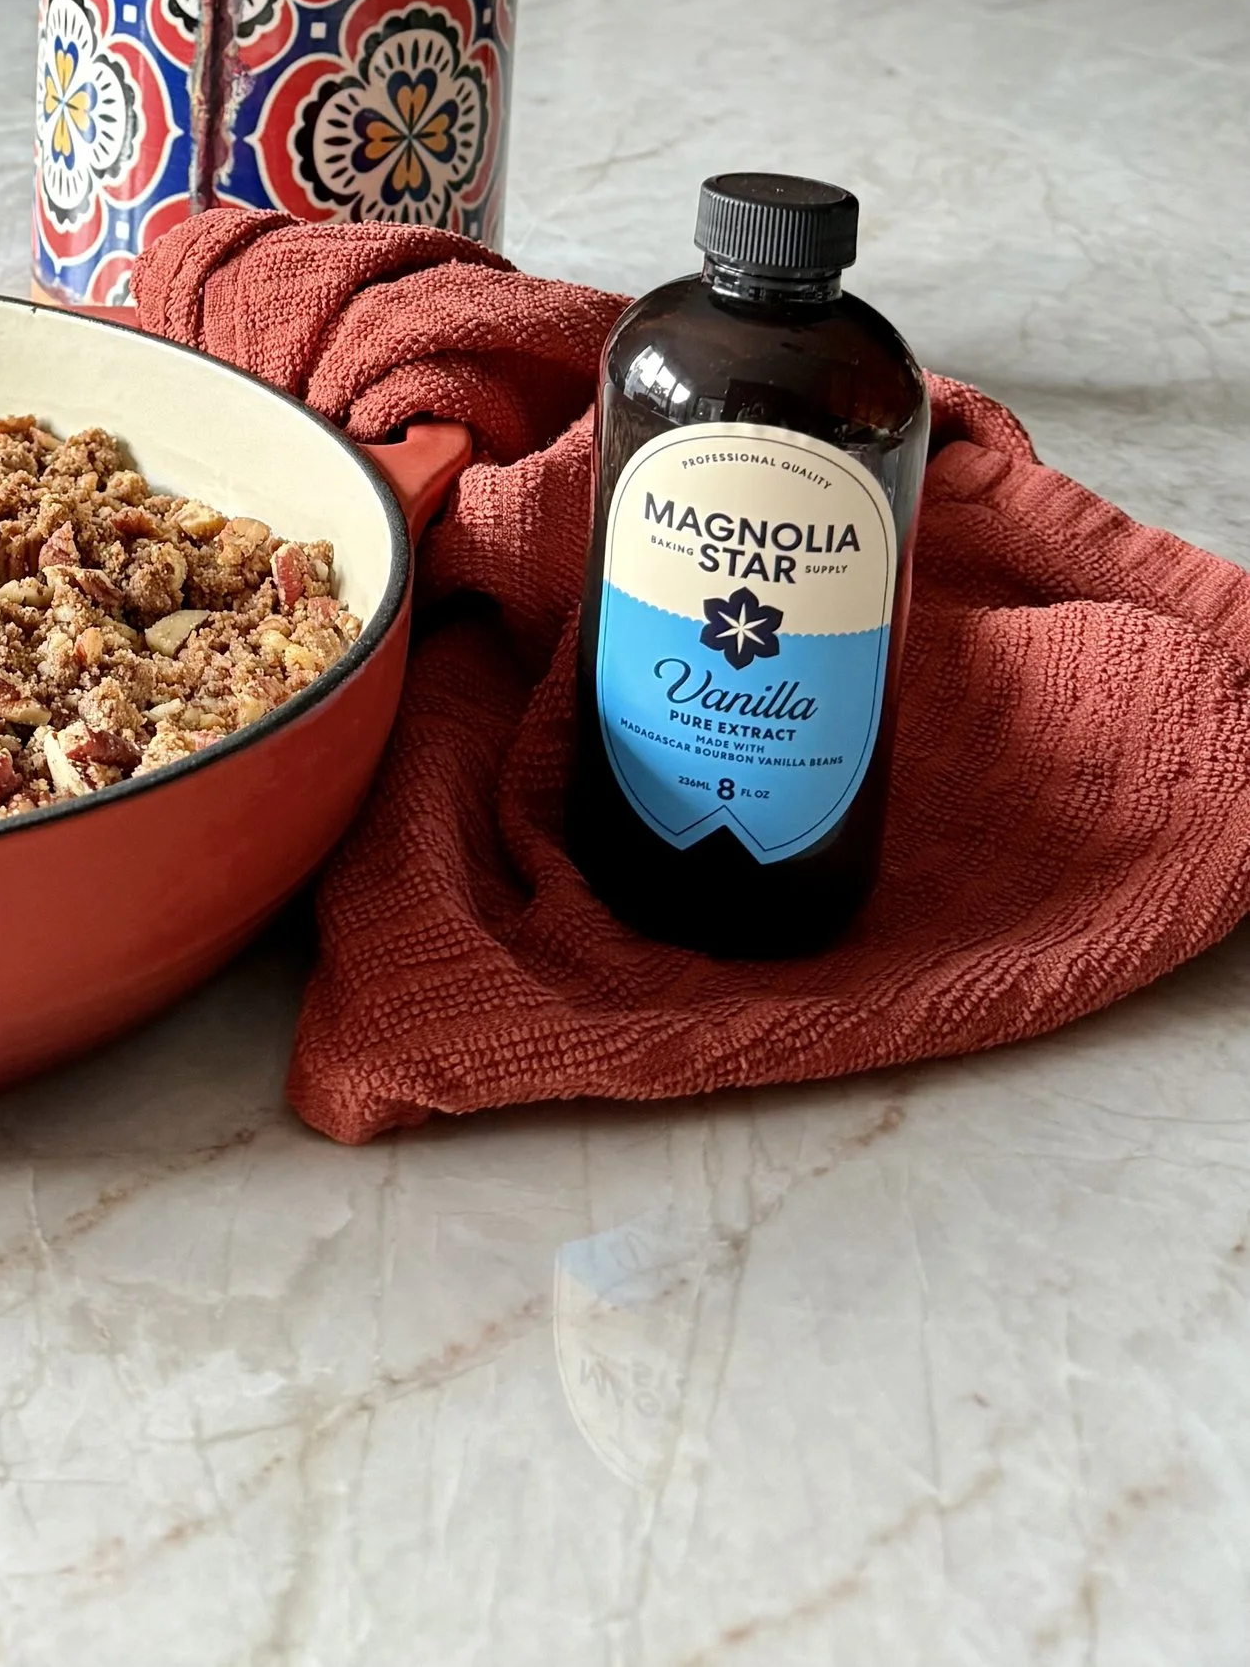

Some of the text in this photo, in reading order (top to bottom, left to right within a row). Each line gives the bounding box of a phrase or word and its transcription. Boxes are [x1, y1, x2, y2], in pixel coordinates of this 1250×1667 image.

[682, 453, 833, 490] PROFESSIONAL QUALITY
[644, 491, 861, 553] MAGNOLIA
[651, 535, 694, 556] BAKING
[698, 543, 796, 584] STAR
[805, 565, 848, 574] SUPPLY
[653, 658, 819, 721] Vanilla
[620, 717, 843, 767] MADAGASCAR BOURBON VANILLA BEANS
[669, 709, 797, 741] PURE EXTRACT
[696, 734, 765, 753] MADE WITH
[678, 775, 770, 800] 236ML 8 FL OZ
